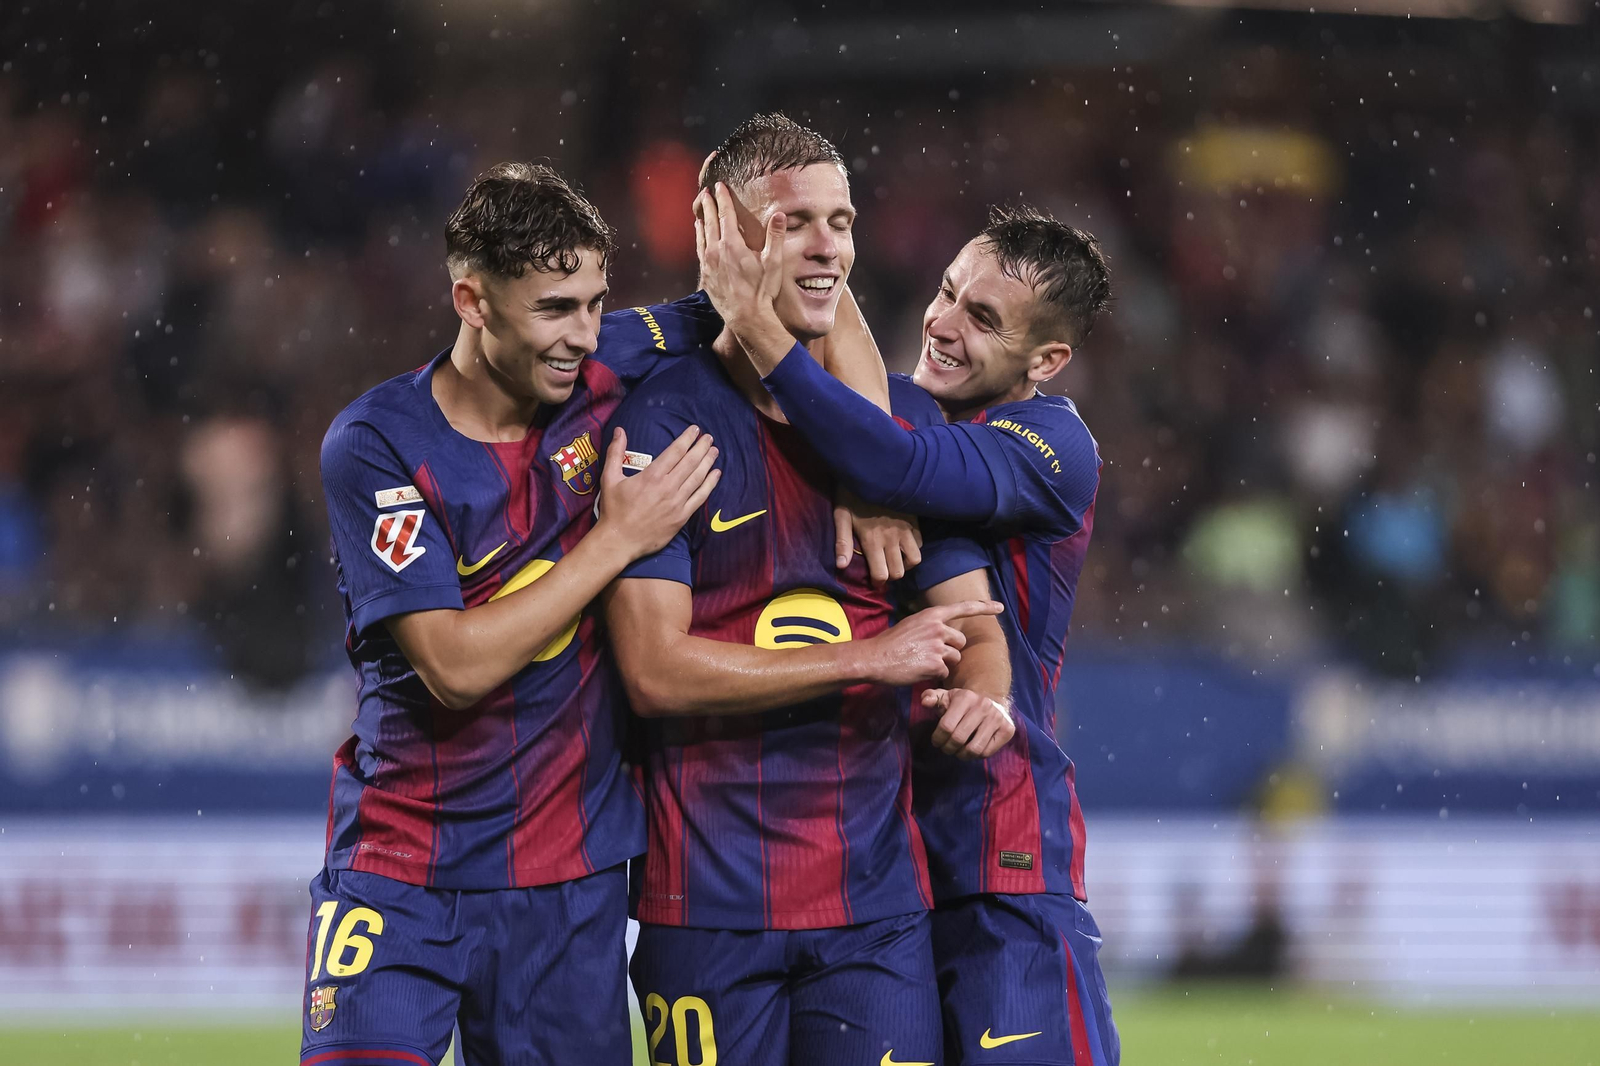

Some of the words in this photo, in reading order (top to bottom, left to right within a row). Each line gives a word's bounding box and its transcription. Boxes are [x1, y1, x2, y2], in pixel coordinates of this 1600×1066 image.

[630, 306, 667, 351] AMBILIG
[574, 459, 590, 474] FCB
[986, 419, 1056, 459] MBILIGHT
[1050, 459, 1062, 474] tv
[309, 900, 385, 982] 16
[645, 992, 718, 1066] 20
